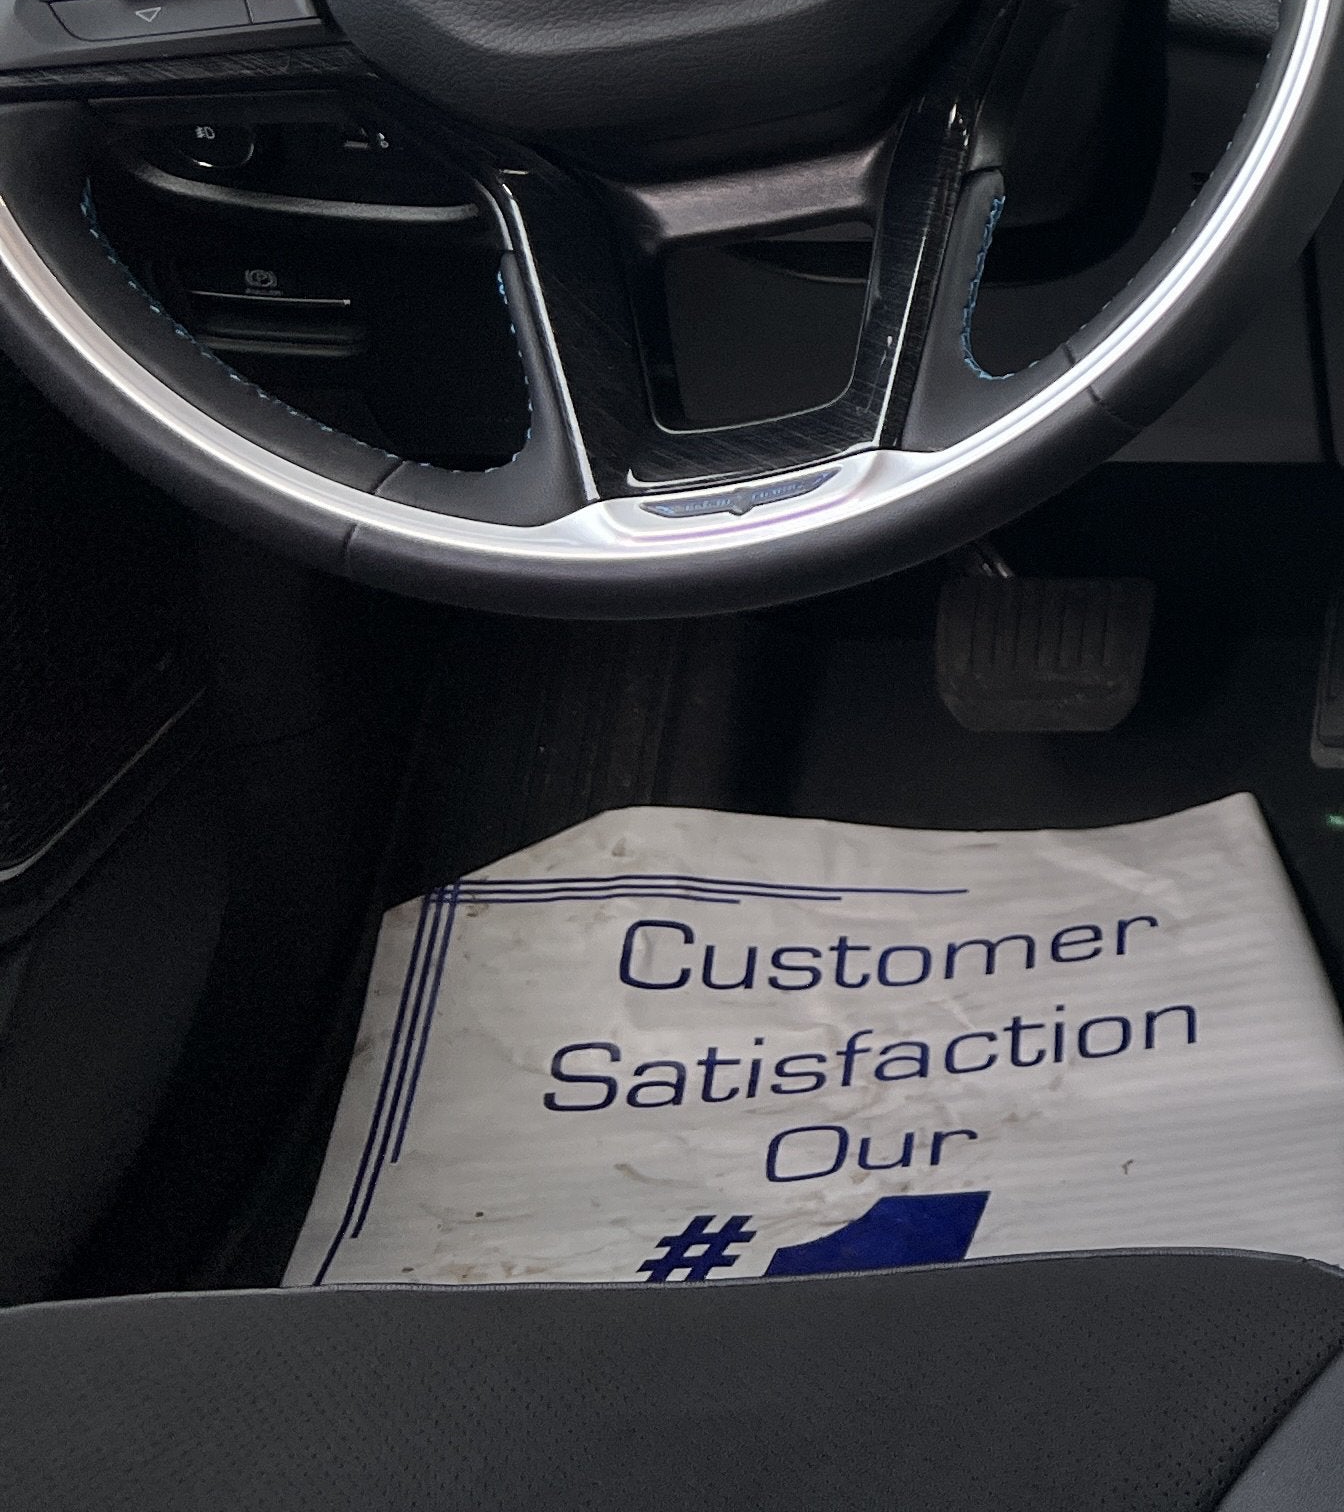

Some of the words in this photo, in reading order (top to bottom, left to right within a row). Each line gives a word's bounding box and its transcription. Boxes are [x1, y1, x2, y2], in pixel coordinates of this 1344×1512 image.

[618, 912, 1158, 992] Customer
[542, 1000, 1199, 1113] Satisfaction
[764, 1123, 979, 1183] Our
